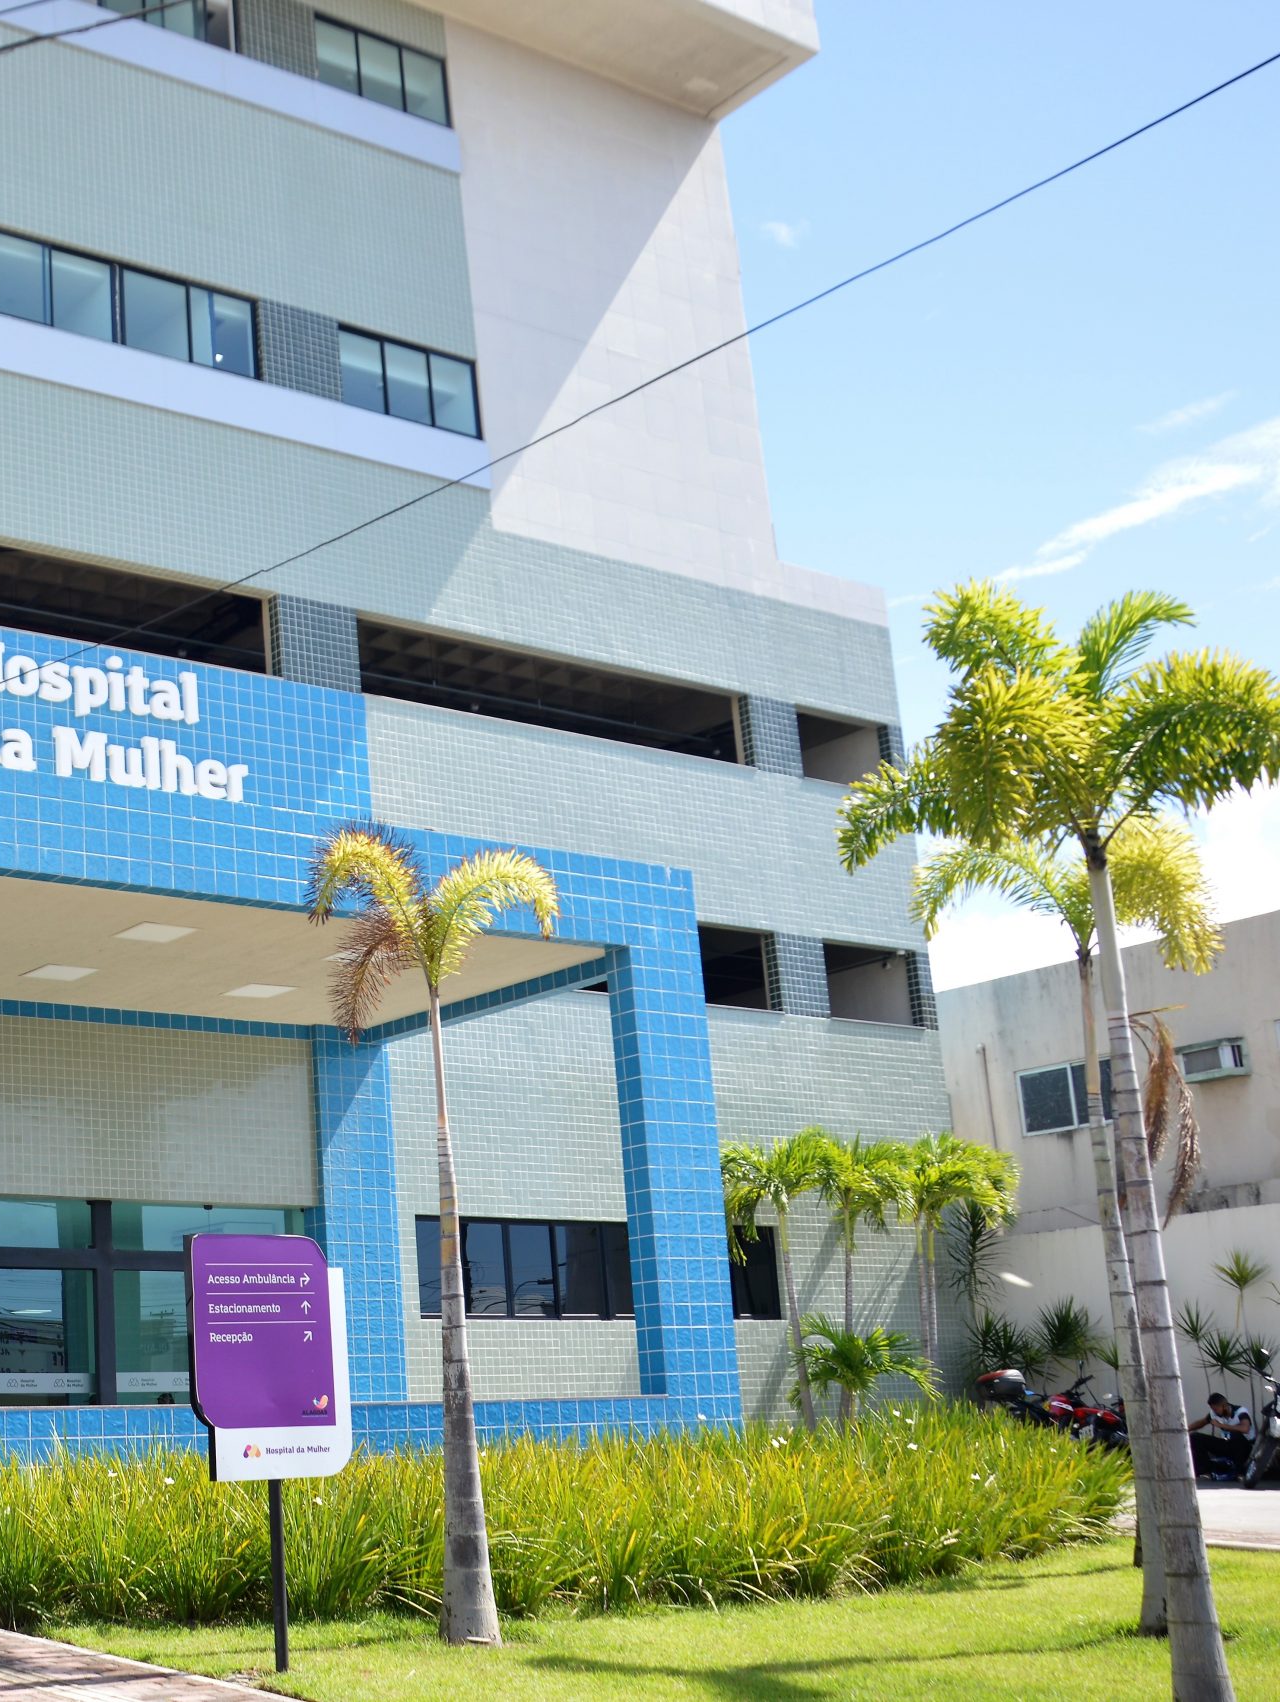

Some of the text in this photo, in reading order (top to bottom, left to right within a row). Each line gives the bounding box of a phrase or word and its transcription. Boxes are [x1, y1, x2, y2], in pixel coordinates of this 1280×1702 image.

[53, 725, 250, 803] Mulher
[208, 1273, 296, 1284] Acesso Ambulância
[208, 1303, 281, 1314] Estacionamento
[209, 1332, 253, 1343] Recepção
[265, 1446, 295, 1455] Hospital
[307, 1445, 331, 1453] Mulher
